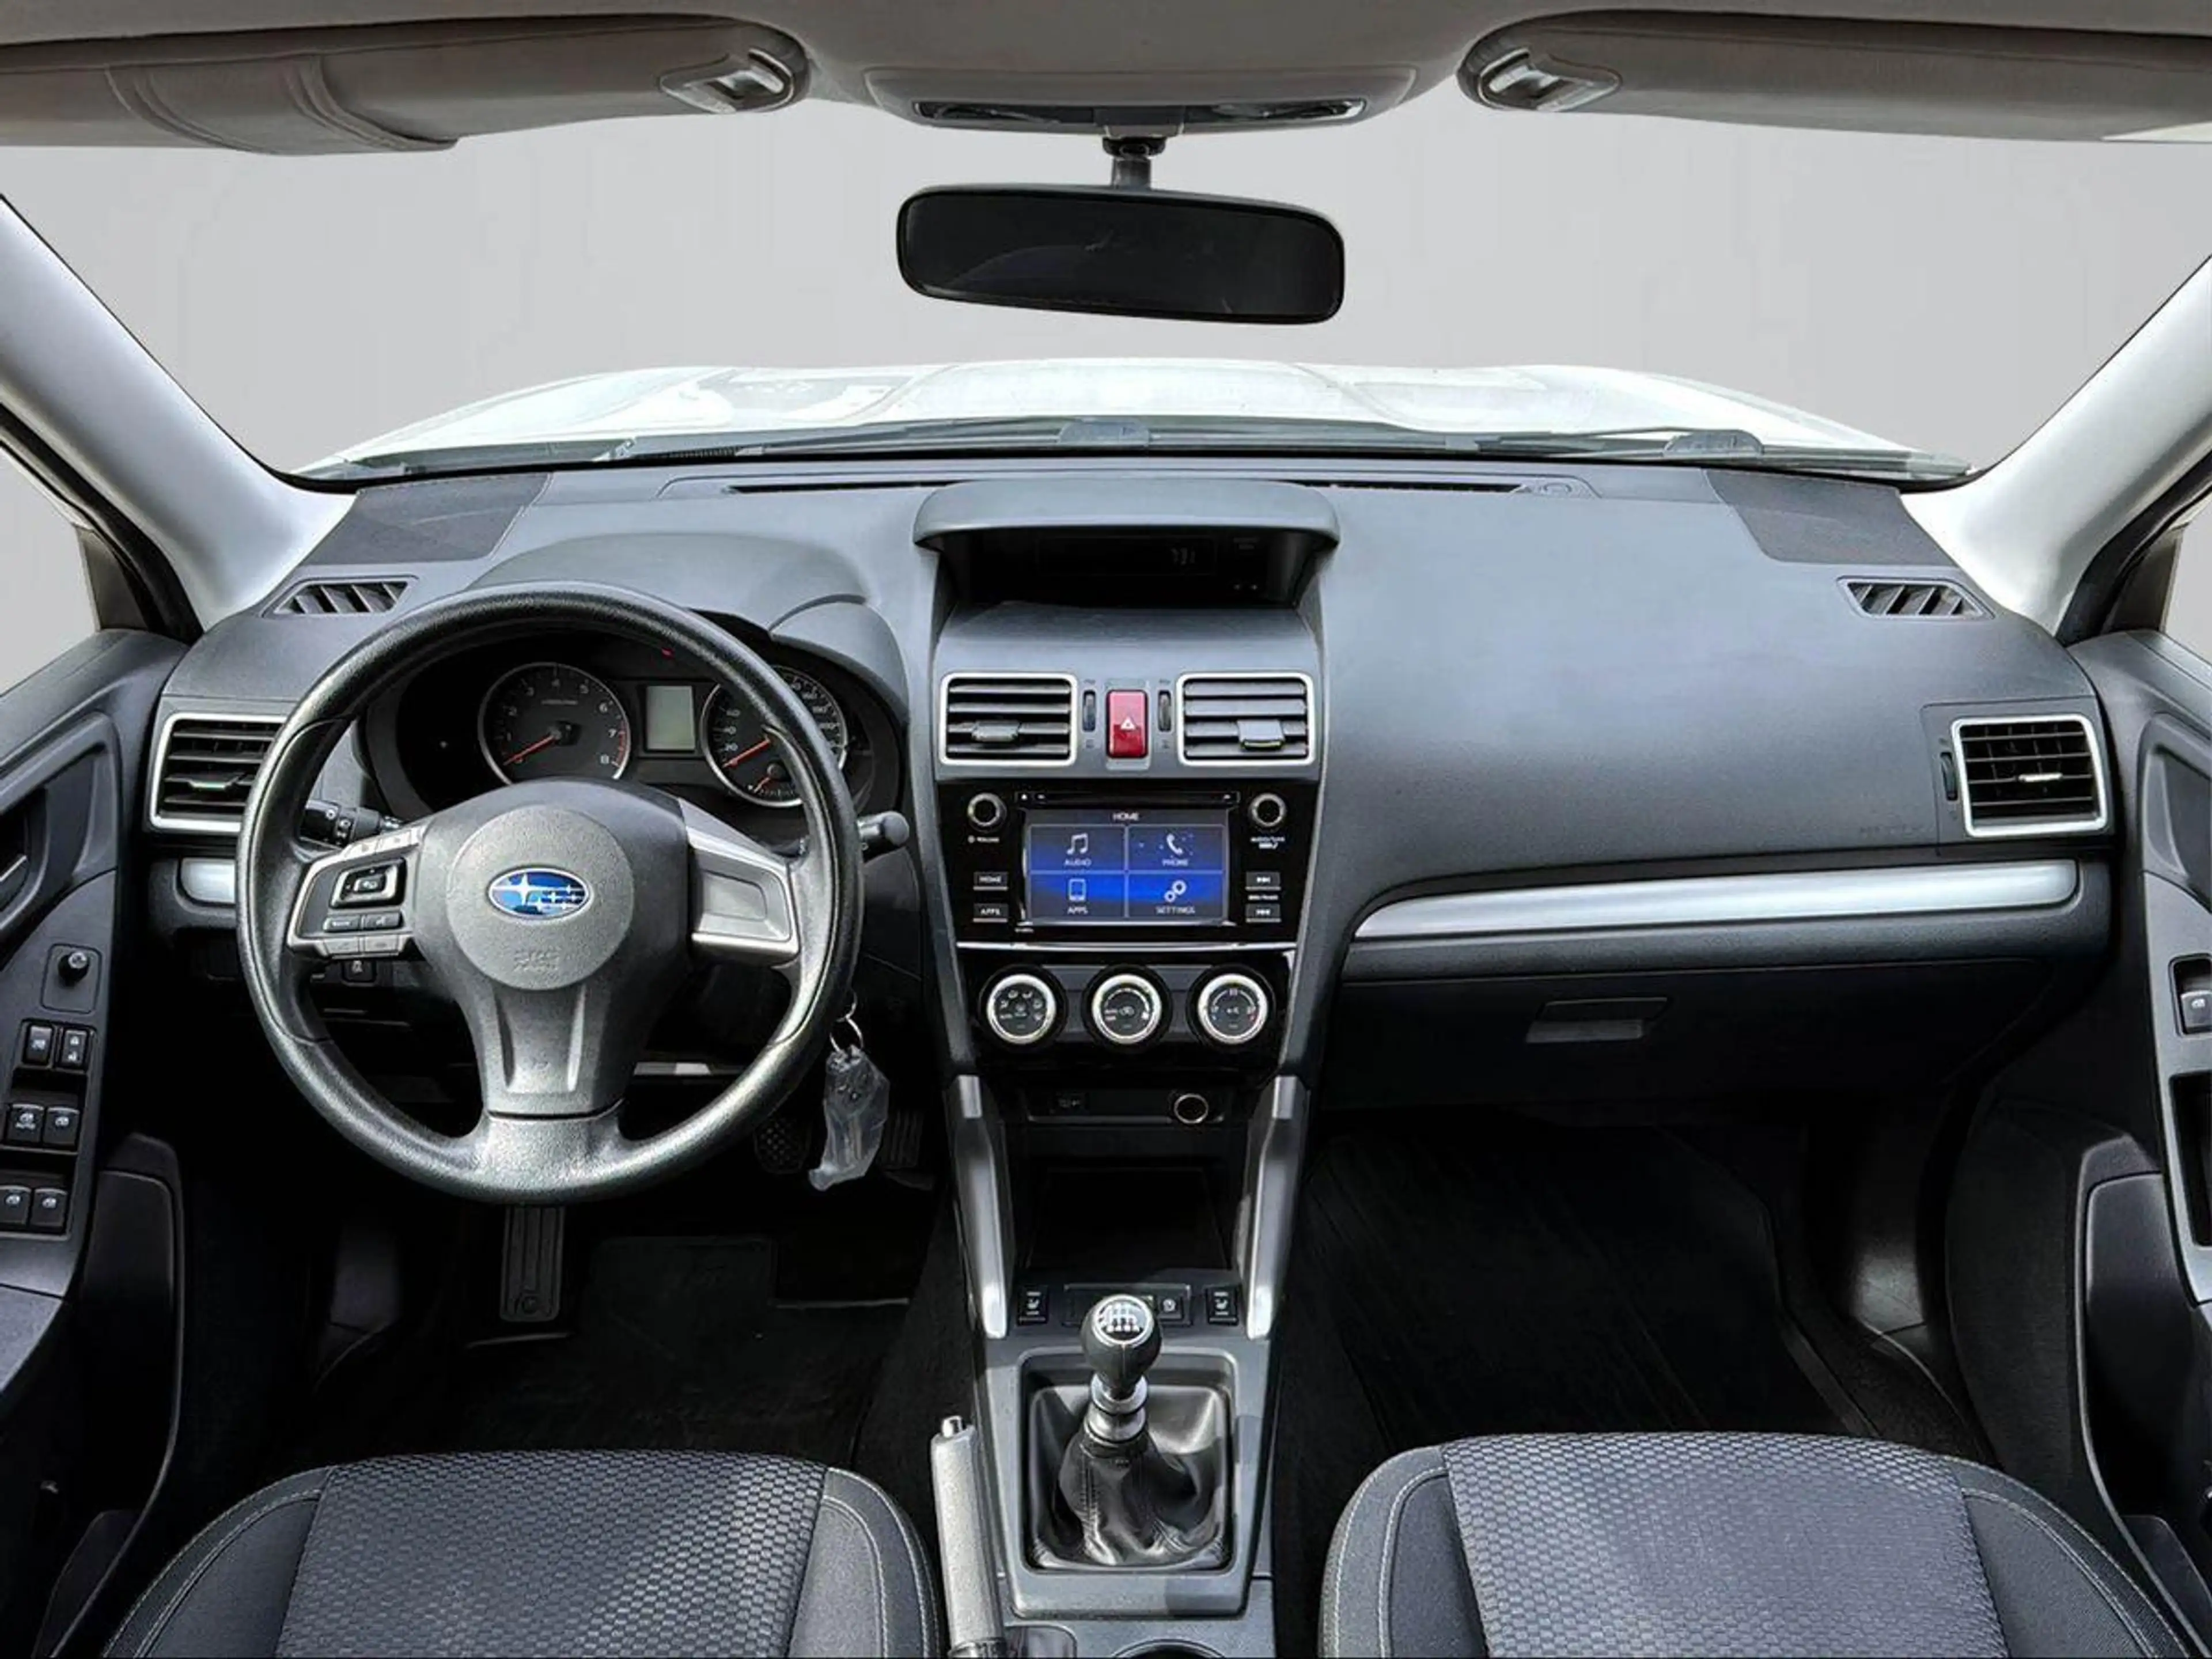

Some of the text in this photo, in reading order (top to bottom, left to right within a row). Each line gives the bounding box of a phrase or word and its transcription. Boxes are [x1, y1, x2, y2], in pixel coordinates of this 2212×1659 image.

[608, 728, 618, 738] 7
[1112, 812, 1139, 821] HOME
[1065, 858, 1092, 867] AUDIO
[1162, 858, 1188, 867] PHONE
[1067, 906, 1088, 915] APPS
[1156, 906, 1195, 915] SETTINGS
